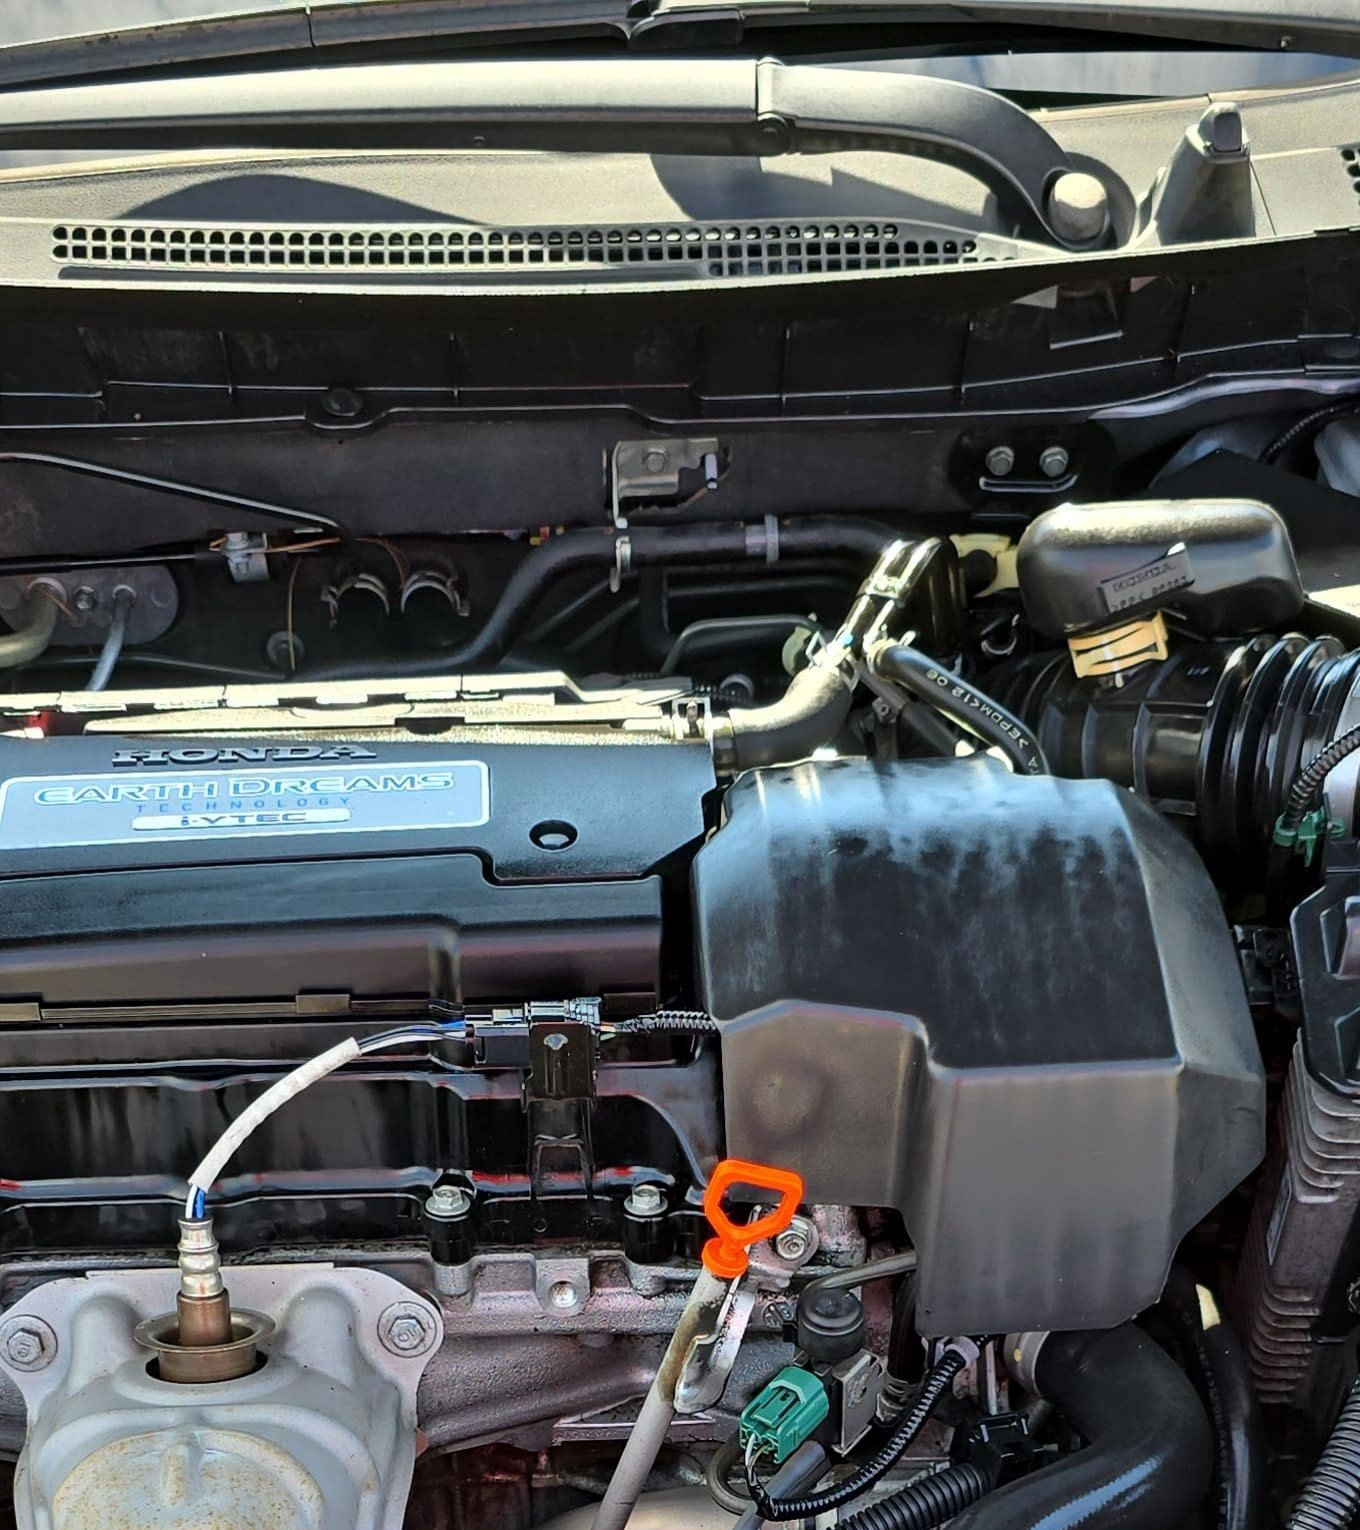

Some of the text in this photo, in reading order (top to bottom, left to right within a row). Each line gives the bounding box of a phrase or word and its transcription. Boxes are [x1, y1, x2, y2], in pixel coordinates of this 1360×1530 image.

[112, 745, 377, 767] HONDA
[34, 771, 455, 805] EARTH DREAMS
[136, 797, 350, 813] TECHNOLOGY
[181, 811, 307, 827] i-VTEC
